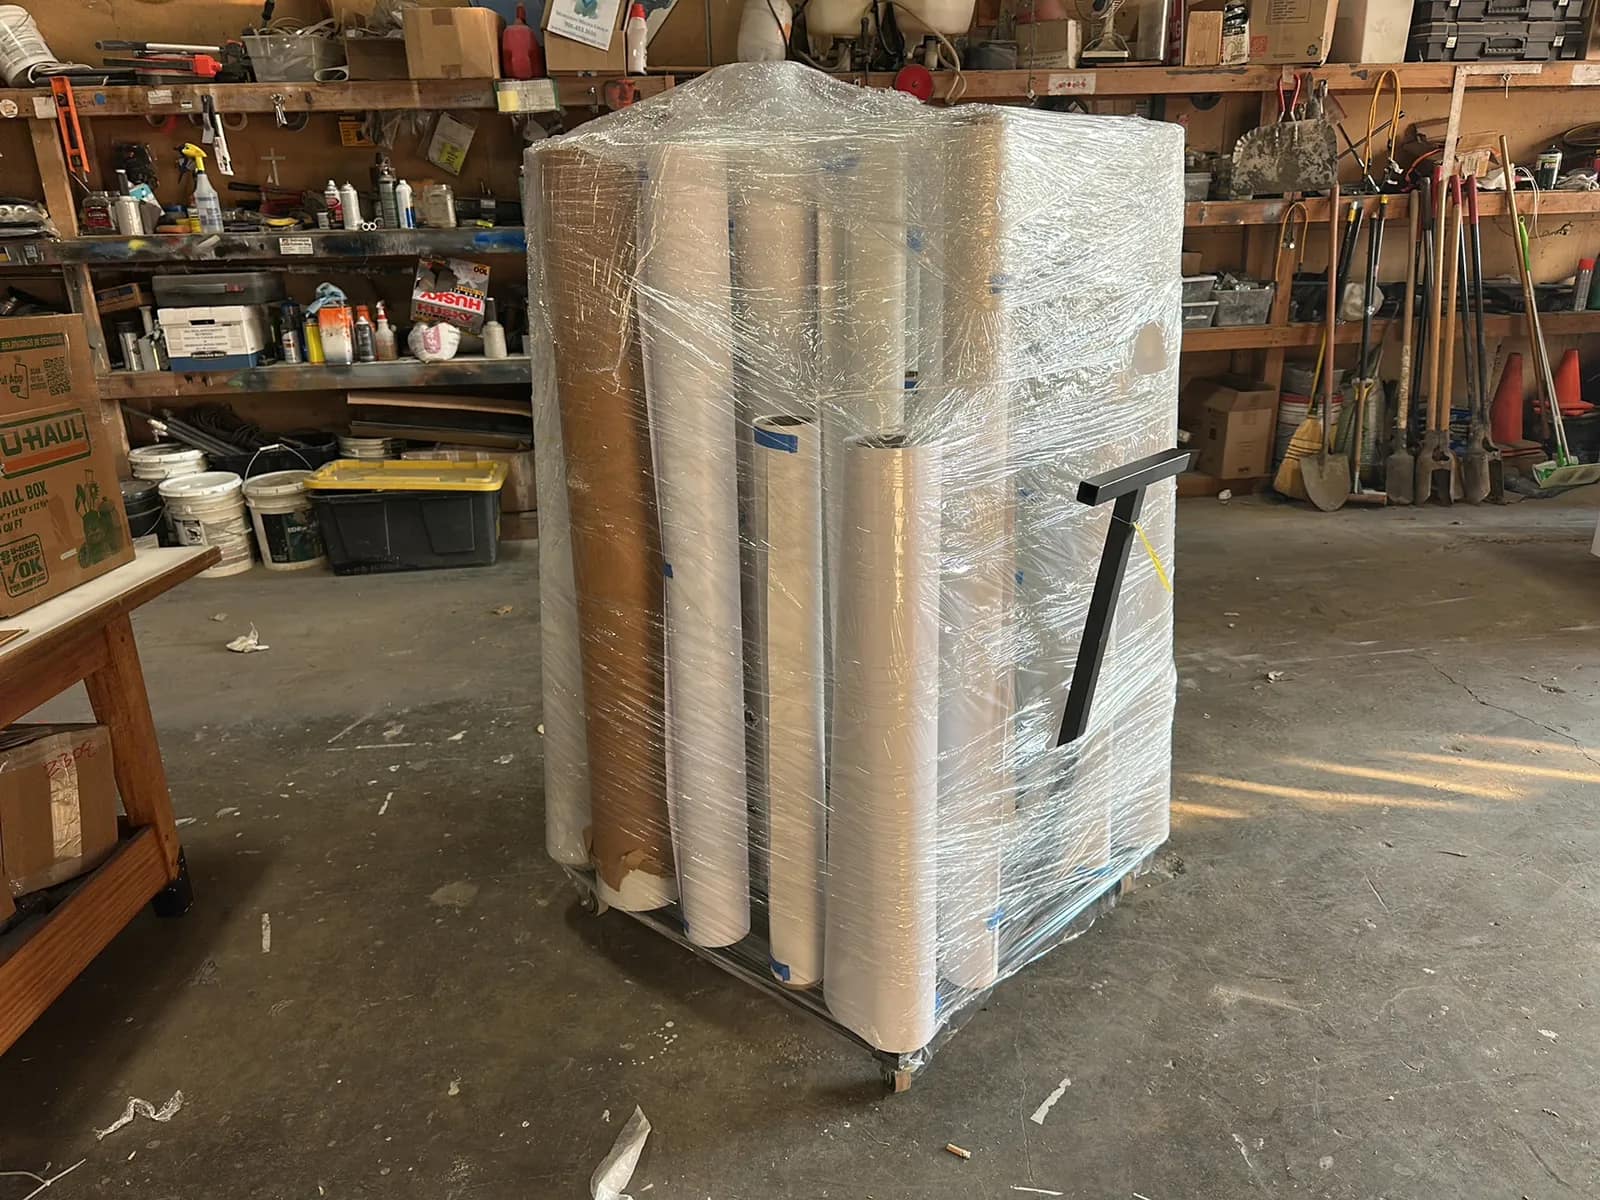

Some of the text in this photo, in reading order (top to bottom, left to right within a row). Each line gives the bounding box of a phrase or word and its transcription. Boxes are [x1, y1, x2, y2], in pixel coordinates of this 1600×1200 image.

[420, 291, 481, 311] HUSKY
[417, 302, 473, 321] HUSKY
[0, 418, 83, 457] U-HAUL
[25, 480, 48, 500] BOX
